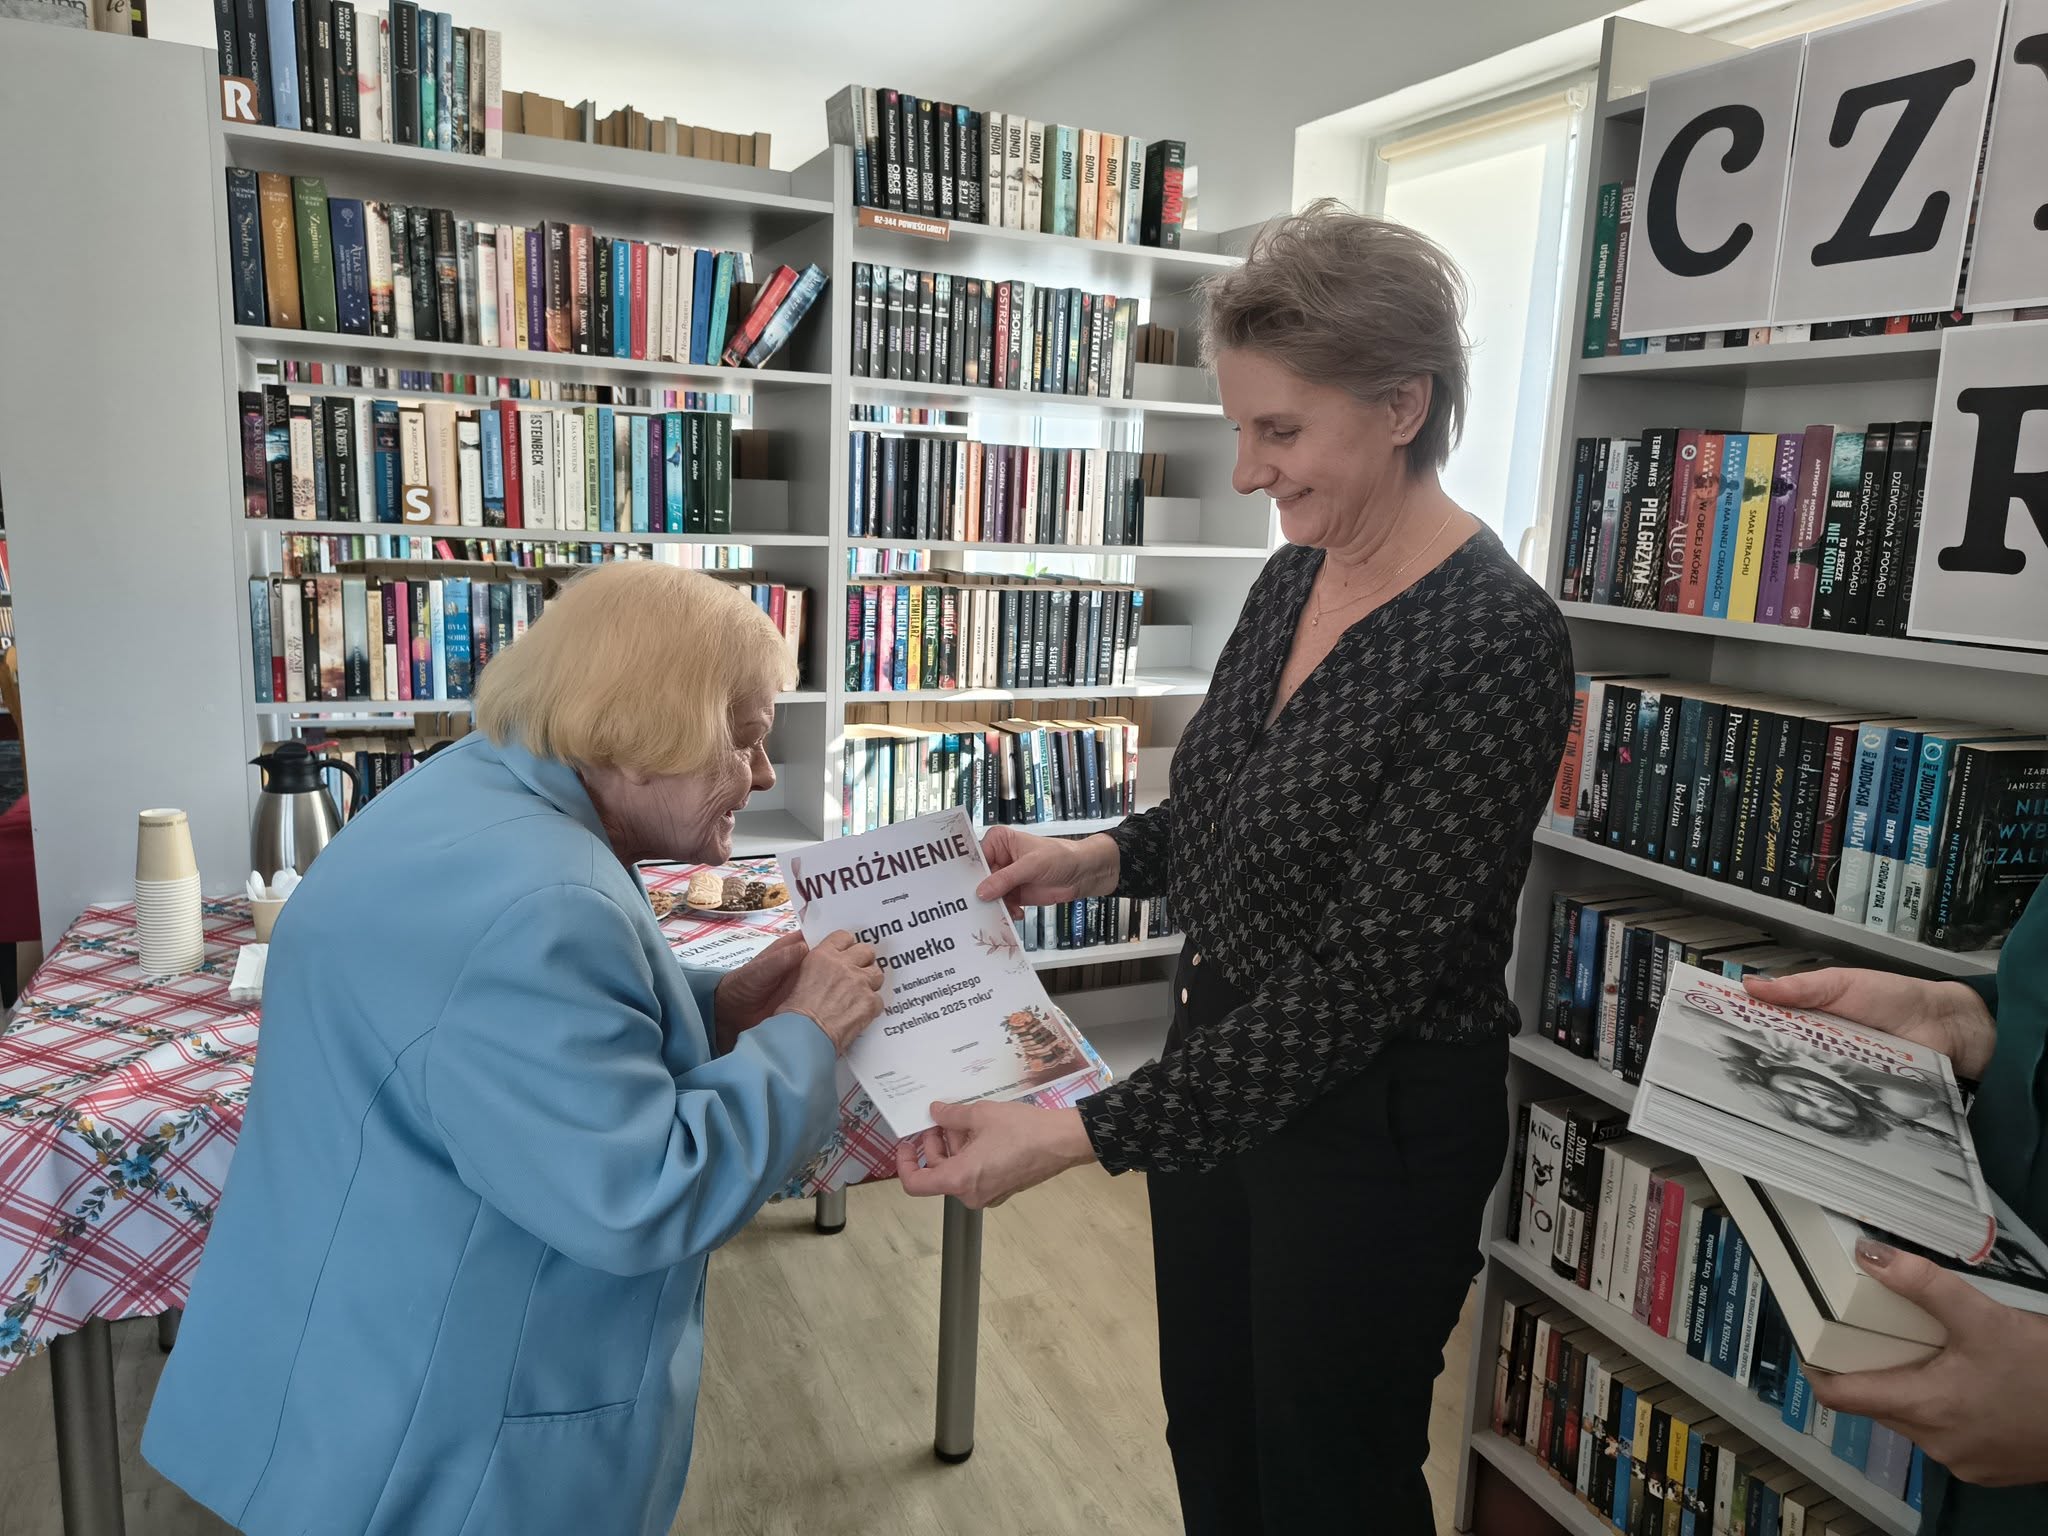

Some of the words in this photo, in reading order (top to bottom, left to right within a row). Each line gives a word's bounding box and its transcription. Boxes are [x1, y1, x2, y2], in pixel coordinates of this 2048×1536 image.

[224, 80, 256, 120] R
[991, 125, 1001, 155] BONDA
[1009, 128, 1021, 159] BONDA
[1030, 134, 1042, 164] BONDA
[892, 164, 901, 195] OBCE
[1062, 151, 1072, 180] BONDA
[1085, 155, 1095, 184] BONDA
[1106, 158, 1118, 187] BONDA
[1130, 161, 1141, 190] BONDA
[1162, 171, 1182, 224] BONDA
[1620, 193, 1634, 224] GREN
[352, 243, 363, 272] ATLAS
[578, 261, 587, 299] ROBERTS
[998, 287, 1009, 331] OSTRZE
[1011, 311, 1021, 353] BORLIK
[1090, 312, 1102, 372] OPIEKUNKA
[334, 406, 348, 428] NORA
[336, 429, 348, 457] ROBERTS
[530, 418, 544, 466] STEINBECK
[589, 437, 597, 456] SIMS
[1651, 435, 1662, 459] TERRY
[1624, 454, 1634, 494] HAWKINS
[1631, 461, 1640, 487] PAULA
[1648, 462, 1659, 487] HAYES
[1811, 458, 1821, 498] ANTHONY
[406, 488, 431, 521] S
[1700, 502, 1708, 511] W
[1725, 492, 1733, 507] NIE
[1831, 500, 1852, 508] HUGHES
[1836, 490, 1850, 499] EGAN
[1857, 472, 1874, 538] DZIEWCZYNA
[1884, 472, 1902, 538] DZIEWCZYNA
[1621, 501, 1632, 544] POWOLNE
[1695, 513, 1705, 548] OBCEJ
[1724, 509, 1731, 520] MA
[1747, 509, 1757, 534] SMAK
[1805, 497, 1817, 541] HOROWITZ
[1632, 497, 1659, 584] PIELGRZYM
[1719, 520, 1728, 549] INNEJ
[1827, 522, 1841, 549] NIE
[1839, 537, 1848, 548] TO
[1616, 547, 1627, 582] SPALANIE
[1690, 549, 1701, 585] SKÓRZE
[1742, 535, 1754, 576] STRACHU
[1820, 551, 1836, 594] KONIEC
[1834, 549, 1846, 582] JESZCZE
[1849, 550, 1862, 596] POCIĄGU
[1713, 550, 1726, 601] CIEMNOŚCI
[1876, 551, 1891, 597] POCIĄGU
[848, 599, 860, 640] CHMIELARZ
[864, 600, 876, 640] CHMIELARZ
[896, 600, 907, 640] CHMIELARZ
[910, 599, 920, 638] CHMIELARZ
[926, 599, 937, 639] CHMIELARZ
[943, 599, 954, 639] CHMIELARZ
[1622, 702, 1636, 743] Siostra
[1659, 706, 1673, 758] Surogatka
[1724, 712, 1743, 763] Prezent
[1566, 735, 1577, 758] TIM
[1743, 719, 1759, 797] NIEWIDZIALNA
[1834, 736, 1844, 774] OKRUTNE
[1559, 762, 1574, 810] JOHNSTON
[1694, 775, 1711, 814] Trzecia
[1797, 750, 1812, 805] IDEALNA
[1825, 774, 1840, 817] PRAGNIENIE
[1855, 758, 1875, 807] JADOWSKA
[1671, 782, 1686, 827] Rodzina
[1915, 770, 1934, 822] JADOWSKA
[1735, 797, 1750, 862] DZIEWCZYNA
[1788, 812, 1803, 868] RODZINA
[796, 834, 969, 902] WYRÓŻNIENIE
[1938, 833, 1960, 922] NIEWYBACZALNE
[907, 897, 969, 928] Janina
[876, 937, 956, 973] Pawełko
[893, 985, 902, 994] w
[902, 972, 944, 991] konkursie
[944, 967, 956, 977] na
[1649, 946, 1664, 1010] DZIENNIKARZ
[883, 1013, 940, 1037] Czytelnika
[940, 1000, 967, 1016] 2025
[1606, 1003, 1617, 1046] MEDALION
[1853, 1034, 1916, 1062] Ewa
[1531, 1119, 1561, 1150] KING
[1565, 1120, 1577, 1171] STEPHEN
[1574, 1136, 1588, 1166] KING
[1604, 1176, 1614, 1204] KING
[1627, 1203, 1638, 1230] KING
[1645, 1207, 1657, 1250] STEPHEN
[1641, 1248, 1652, 1273] KING
[1706, 1233, 1715, 1259] smoka
[1701, 1259, 1710, 1279] Oczy
[1727, 1269, 1739, 1297] Danse
[1697, 1285, 1708, 1307] KING
[1725, 1302, 1734, 1325] KING
[1693, 1309, 1706, 1344] STEPHEN
[1718, 1325, 1732, 1361] STEPHEN
